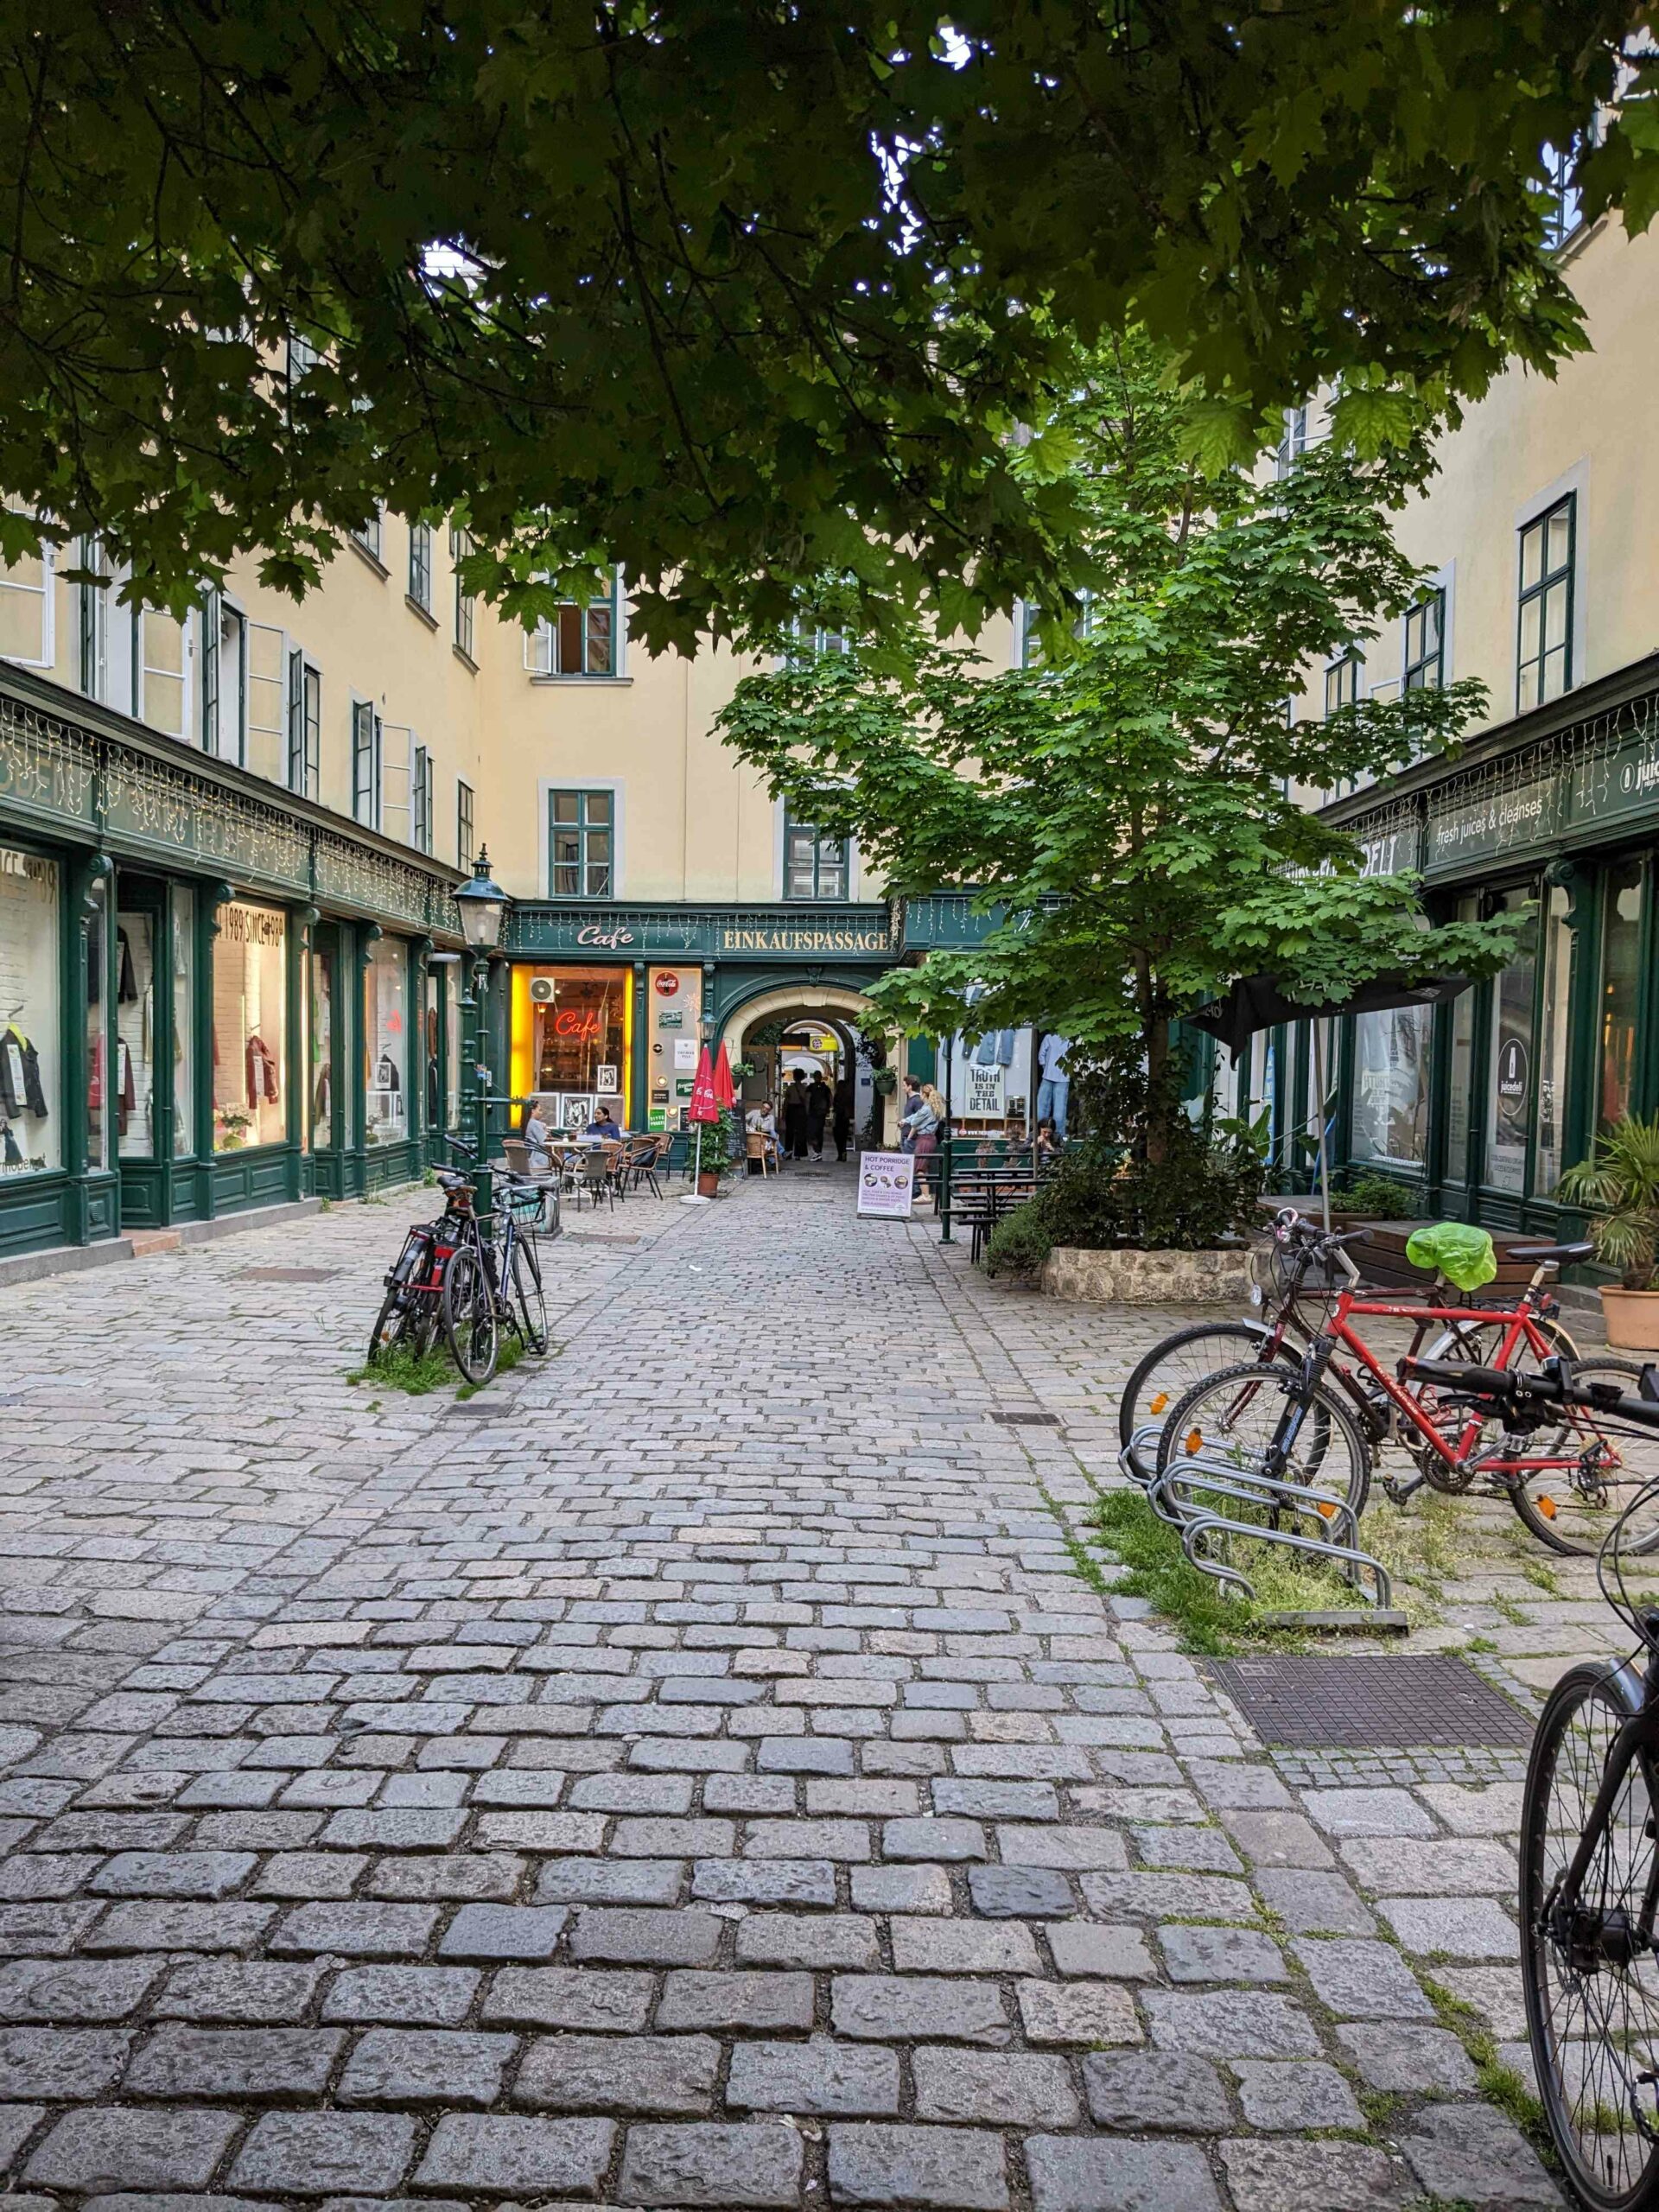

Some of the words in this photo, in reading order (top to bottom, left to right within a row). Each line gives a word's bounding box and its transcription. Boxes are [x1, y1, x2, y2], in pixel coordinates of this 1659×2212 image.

[1437, 824, 1459, 846] fresh
[1459, 817, 1486, 845] juices
[1488, 807, 1497, 830] &
[1499, 798, 1543, 827] cleanses
[226, 906, 243, 942] 1989
[245, 910, 265, 945] SINCE
[577, 925, 634, 950] Cafe
[723, 931, 888, 950] EINKAUFSPASSAGE
[556, 1011, 601, 1042] Cafe
[970, 1069, 1001, 1082] TRUTH
[969, 1097, 1001, 1111] DETAIL
